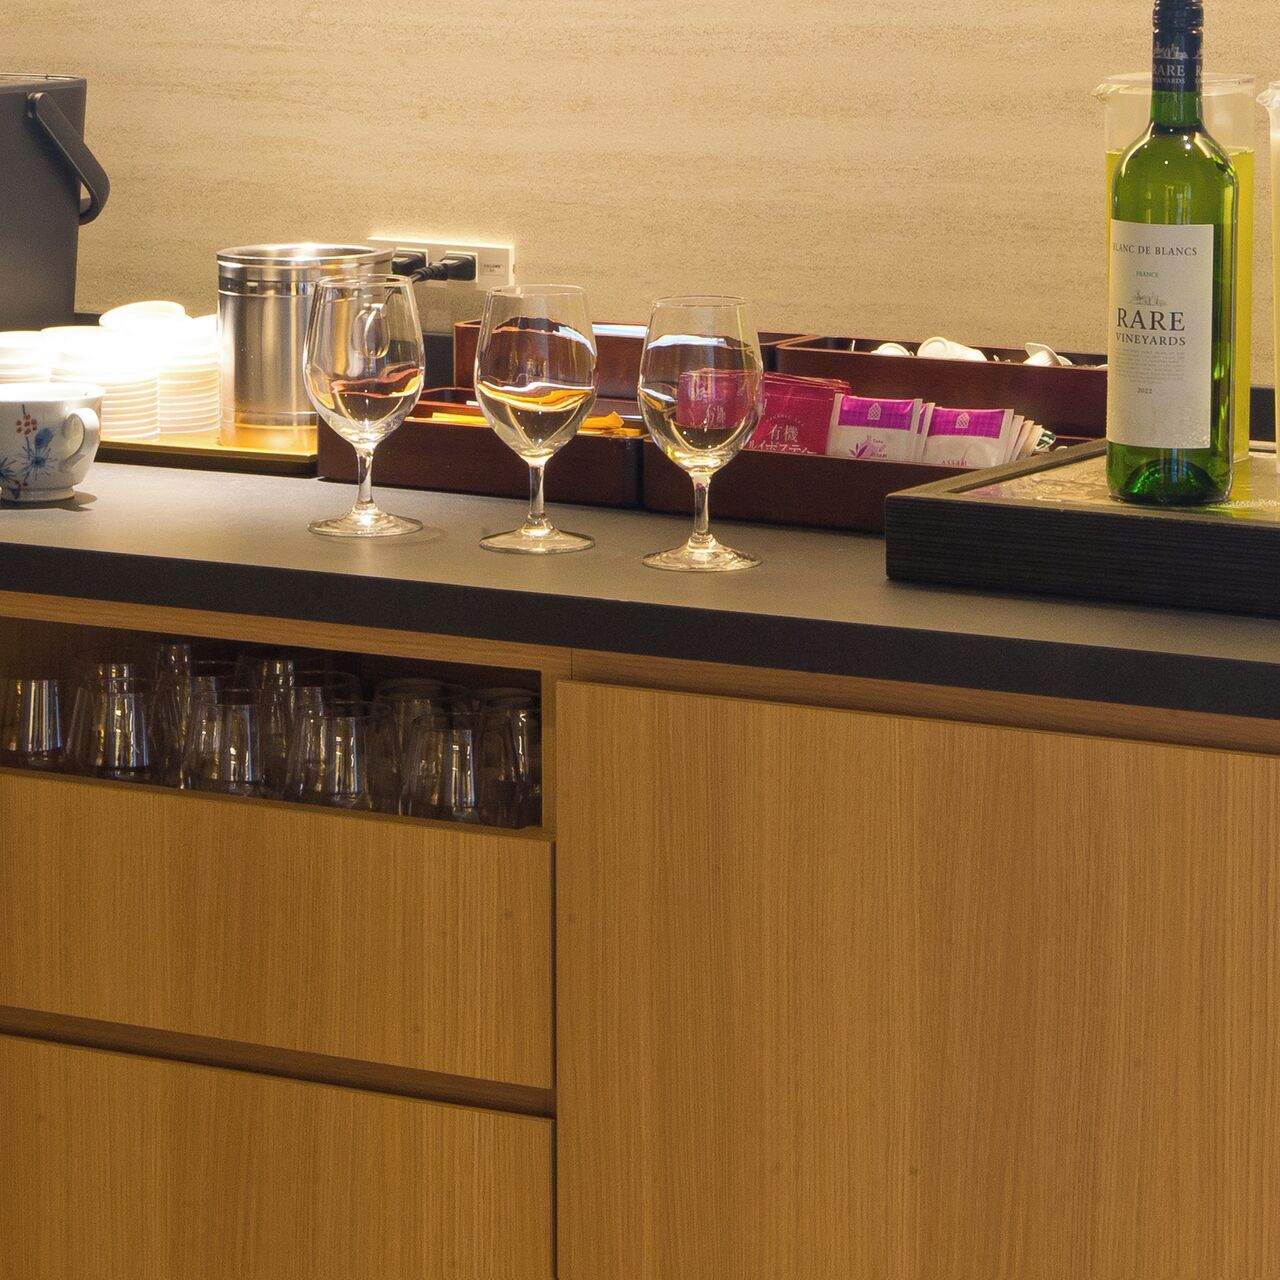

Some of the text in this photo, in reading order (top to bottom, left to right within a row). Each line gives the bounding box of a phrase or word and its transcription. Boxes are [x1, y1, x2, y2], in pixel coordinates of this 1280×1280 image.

[1137, 245, 1151, 255] DE
[1155, 246, 1198, 257] BLANCS
[1116, 307, 1185, 332] RARE
[1115, 332, 1186, 346] VINEYARDS
[768, 424, 799, 442] 有機
